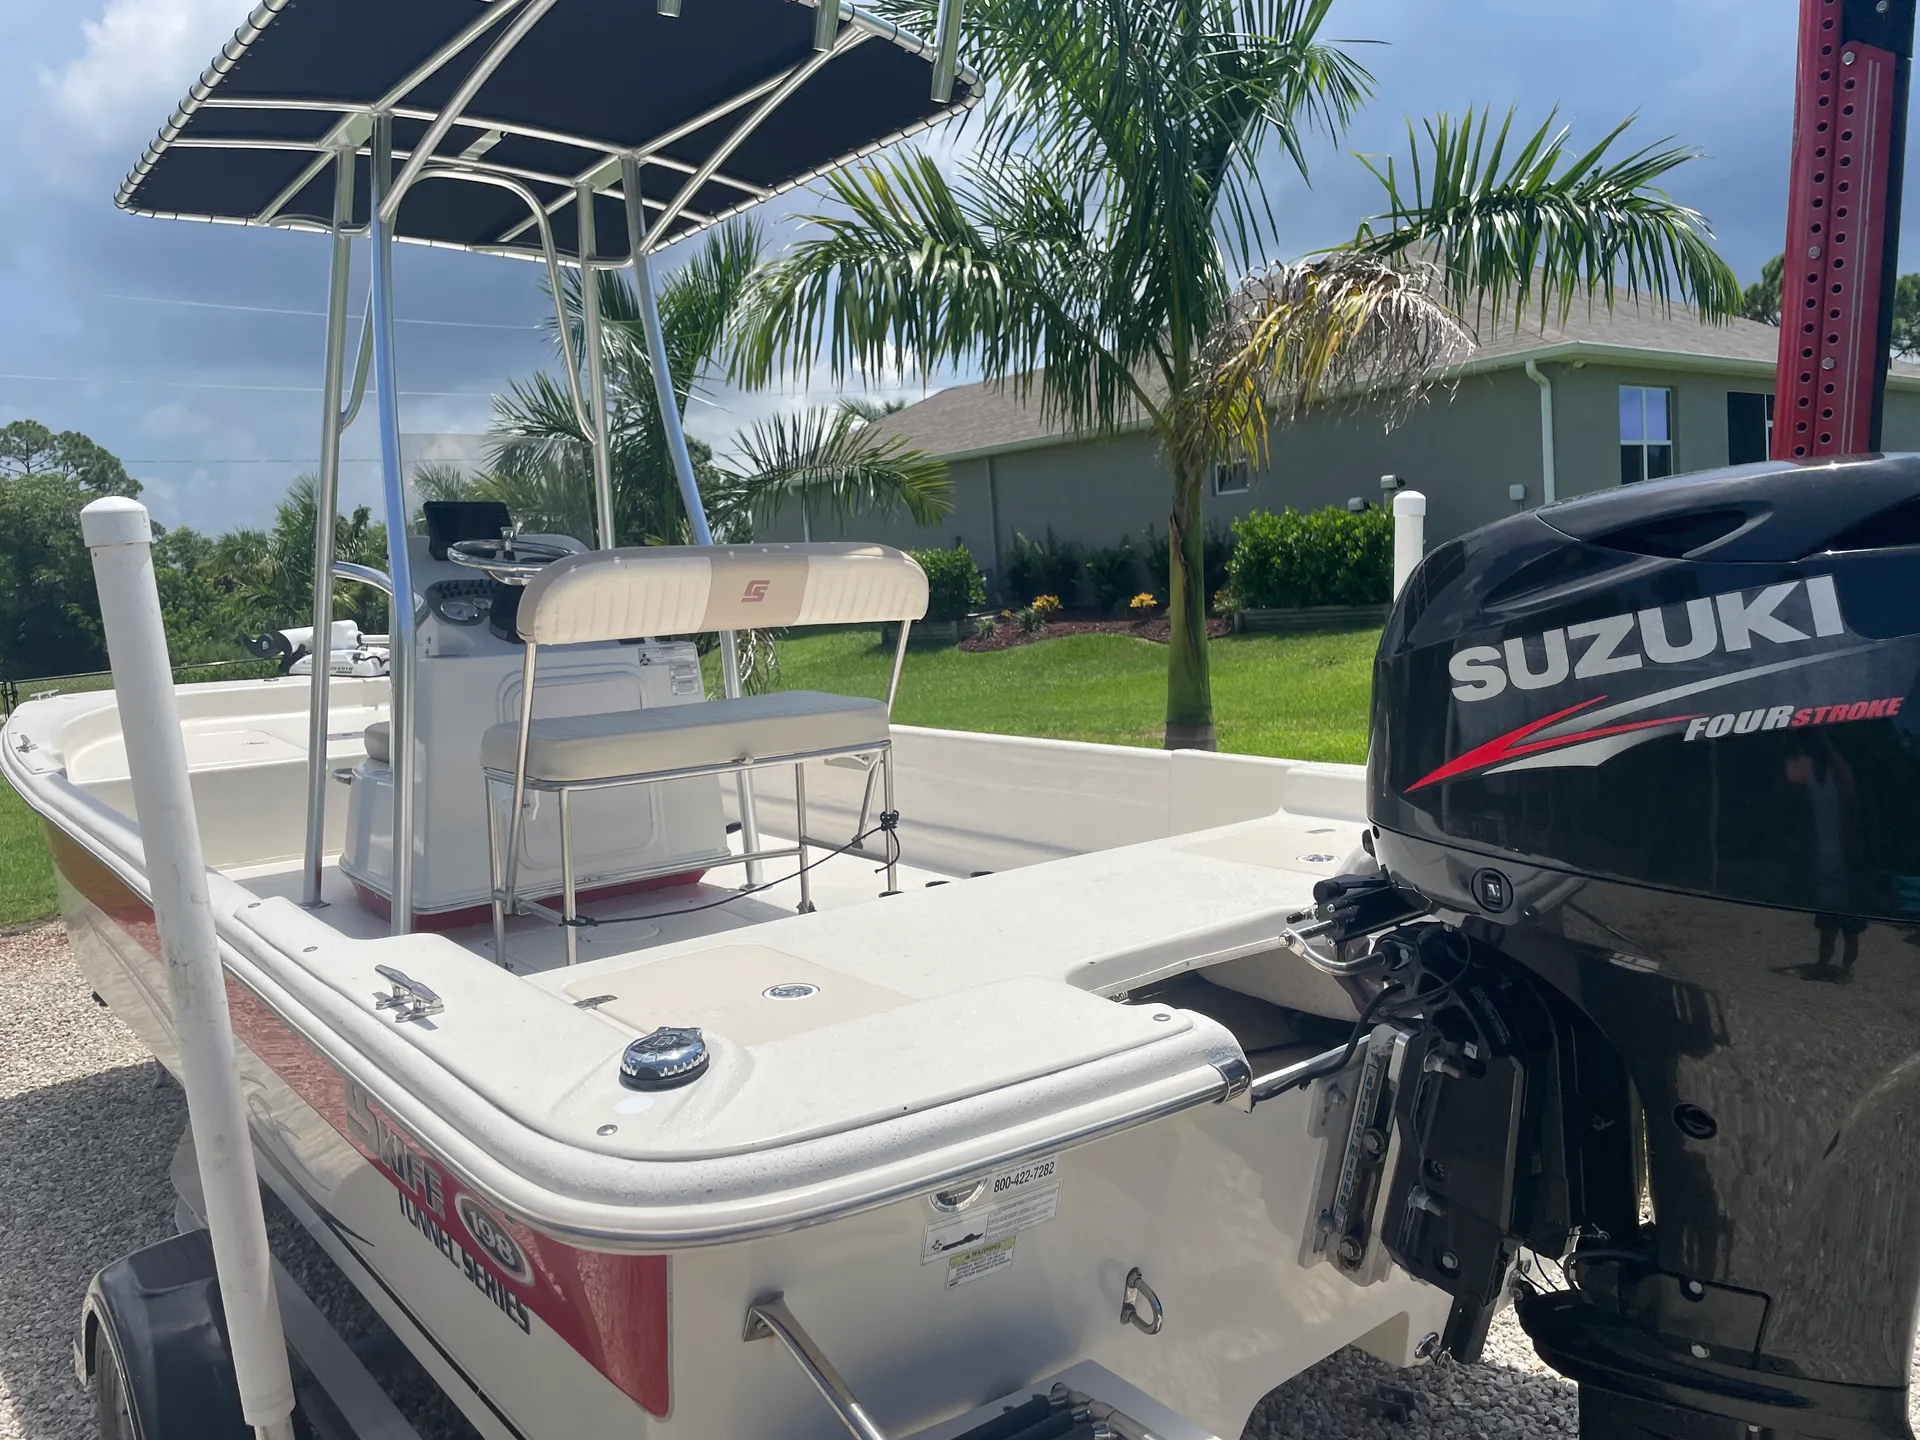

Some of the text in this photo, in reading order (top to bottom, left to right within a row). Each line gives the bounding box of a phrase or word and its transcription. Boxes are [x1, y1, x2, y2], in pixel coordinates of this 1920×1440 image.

[1448, 573, 1845, 702] SUZUKI
[993, 1161, 1056, 1193] 800-422-7282
[397, 1188, 531, 1336] TUNNEL SERIES
[468, 1210, 516, 1266] 198
